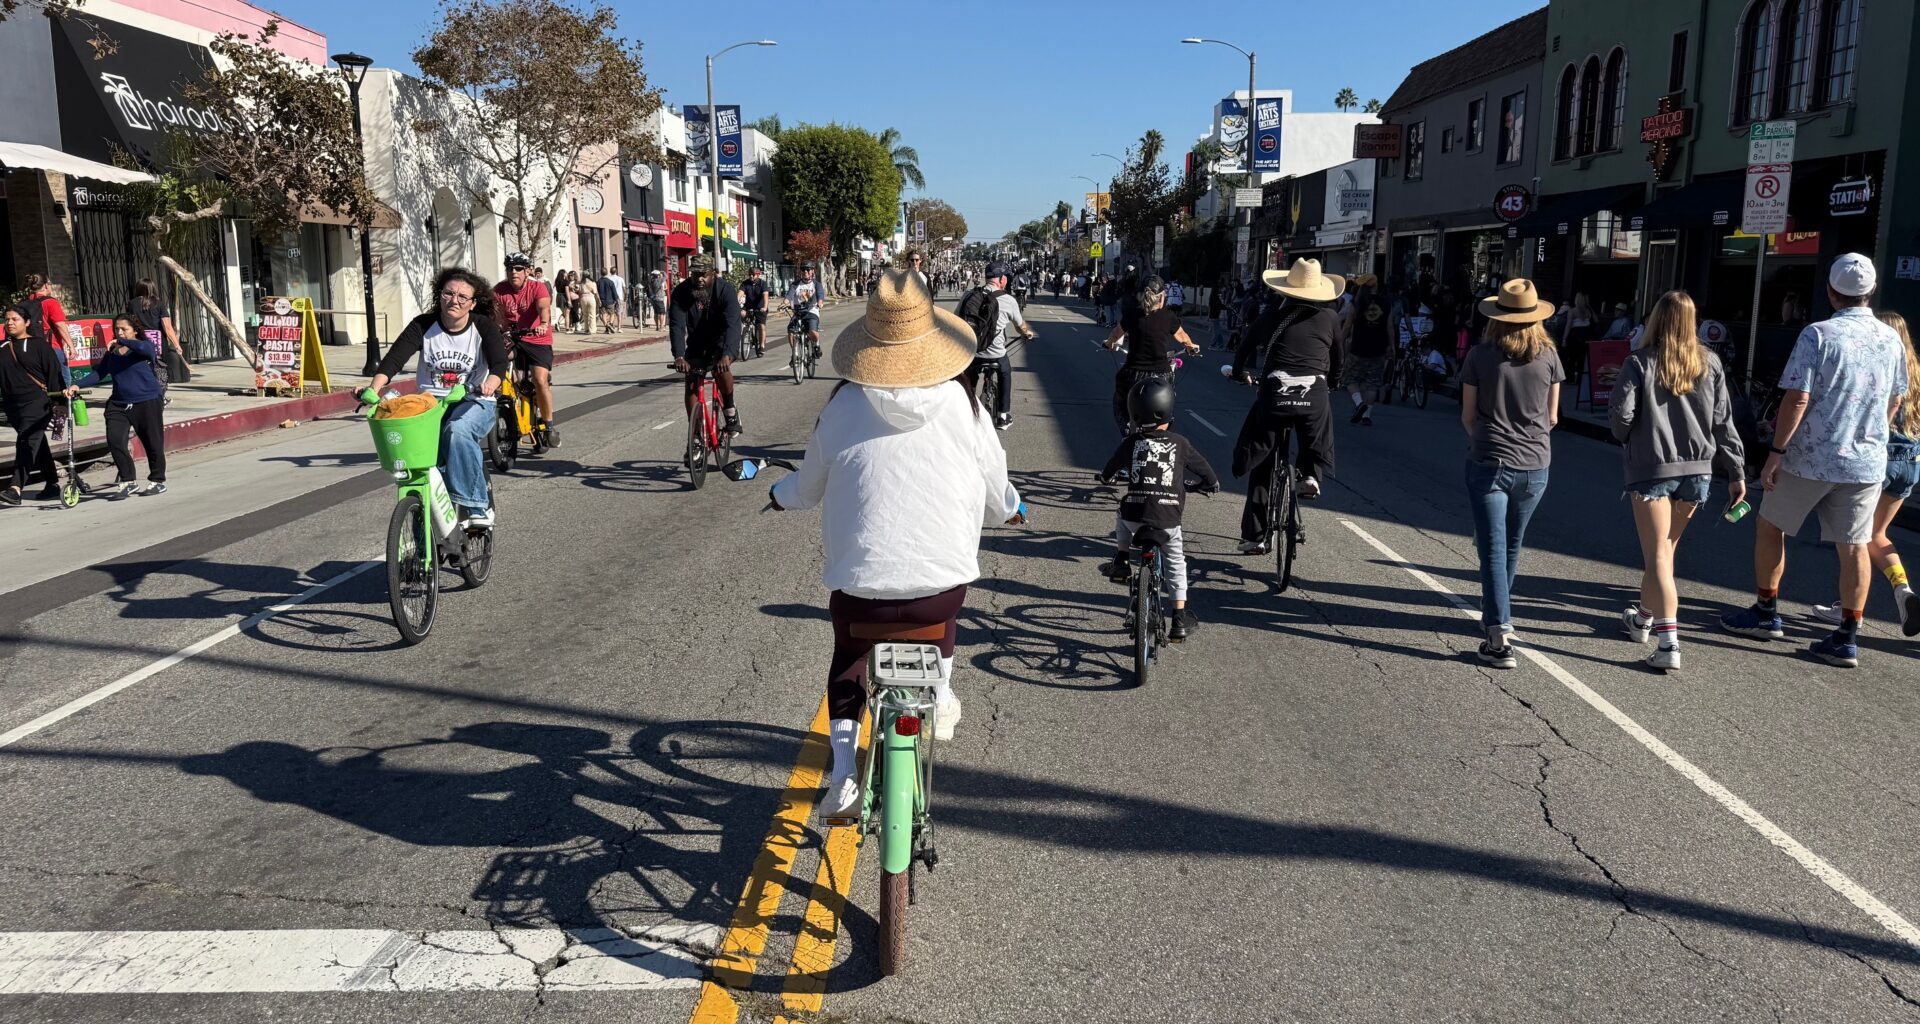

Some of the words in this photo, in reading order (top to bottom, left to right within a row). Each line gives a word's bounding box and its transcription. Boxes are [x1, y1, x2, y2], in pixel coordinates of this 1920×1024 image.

[1258, 107, 1279, 120] ARTS
[1643, 110, 1683, 128] TATTOO
[718, 114, 738, 127] ARTS
[1640, 124, 1681, 142] PIERCING
[1754, 124, 1763, 135] 2
[1766, 126, 1794, 135] PARKING
[1360, 131, 1399, 142] Escape
[1361, 141, 1397, 151] Rooms
[1502, 196, 1523, 211] 43
[671, 219, 691, 236] TATTOO
[287, 247, 300, 258] OPEN
[263, 316, 278, 326] ALL
[280, 316, 299, 327] YOU
[259, 327, 280, 340] CAN
[282, 327, 302, 340] EAT
[265, 340, 294, 351] PASTA
[268, 353, 291, 361] $13.99
[430, 350, 473, 366] HELLFIRE
[440, 361, 462, 370] CLUB
